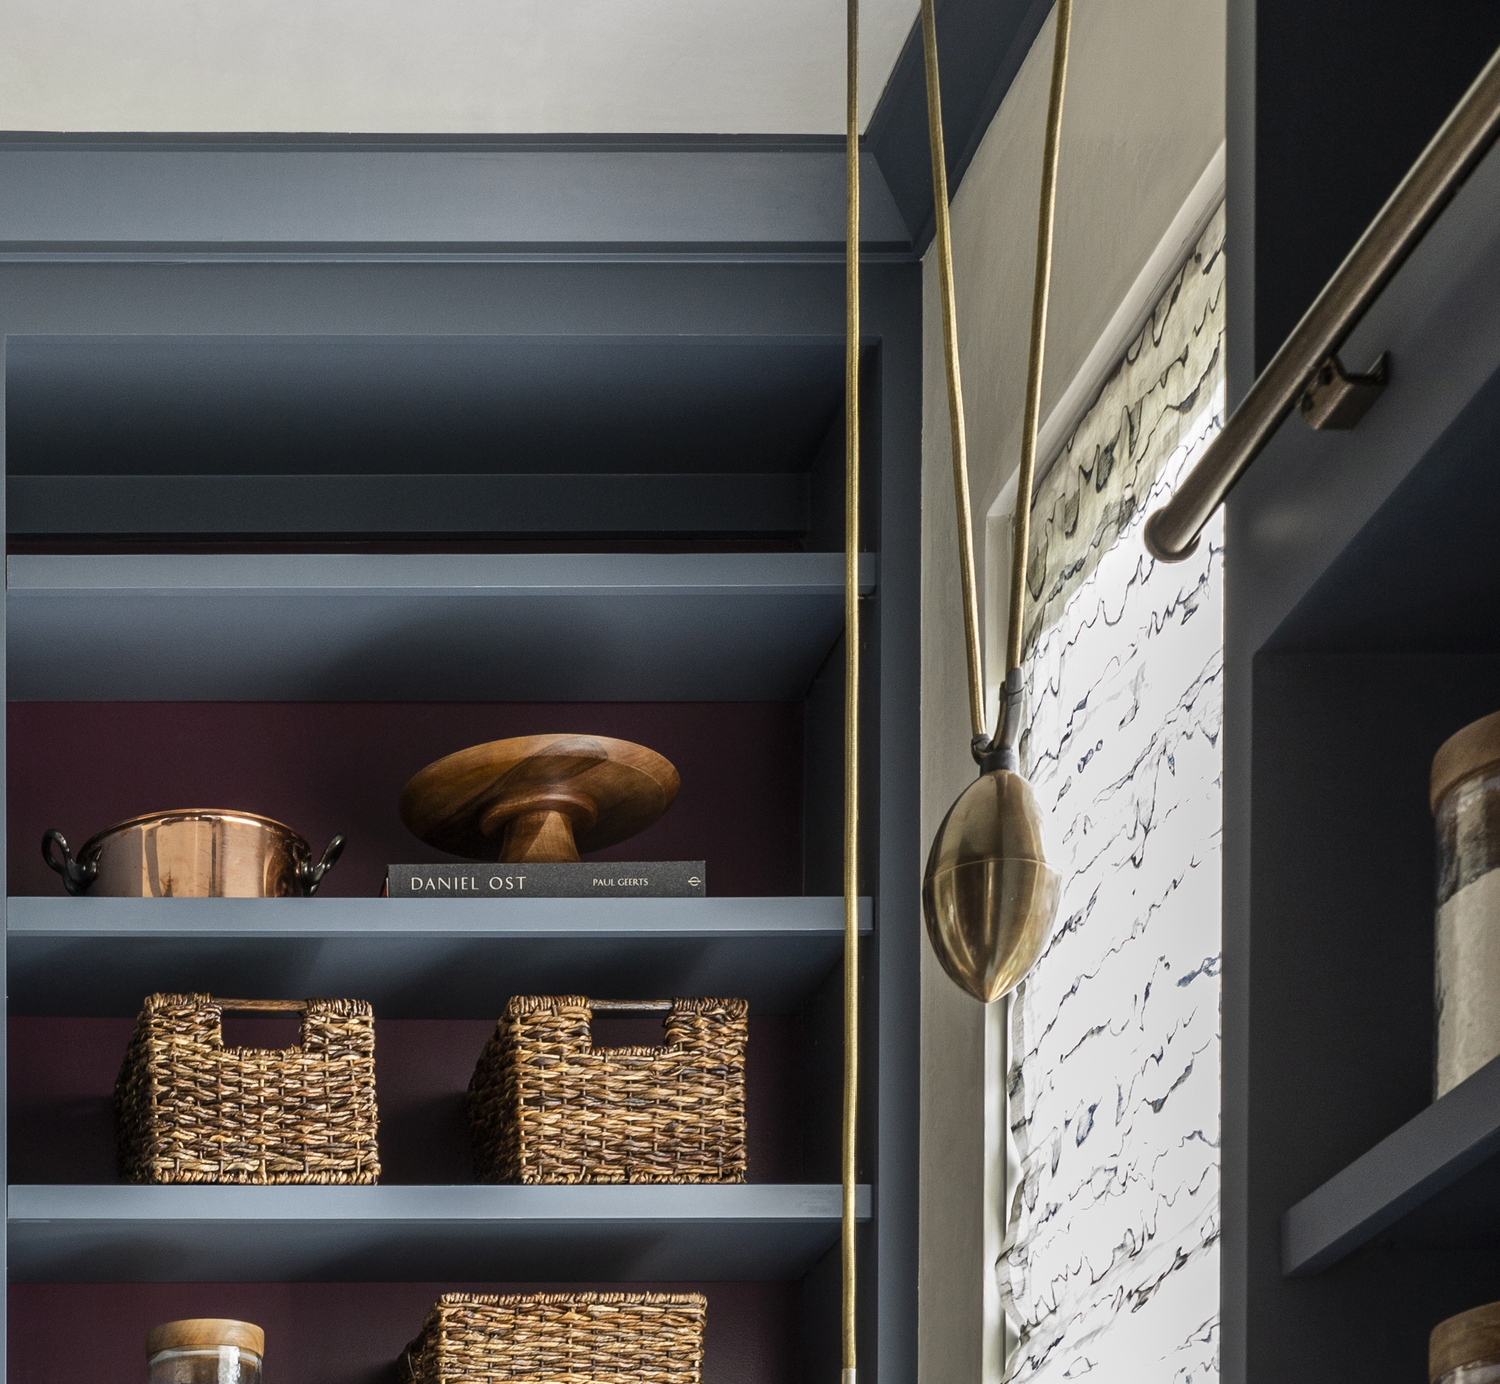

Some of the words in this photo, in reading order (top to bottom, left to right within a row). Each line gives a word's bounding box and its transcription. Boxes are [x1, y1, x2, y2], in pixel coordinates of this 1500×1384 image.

[411, 876, 479, 891] DANIEL
[489, 876, 527, 890] OST
[592, 878, 615, 887] PAUL
[617, 877, 649, 887] GEERTS
